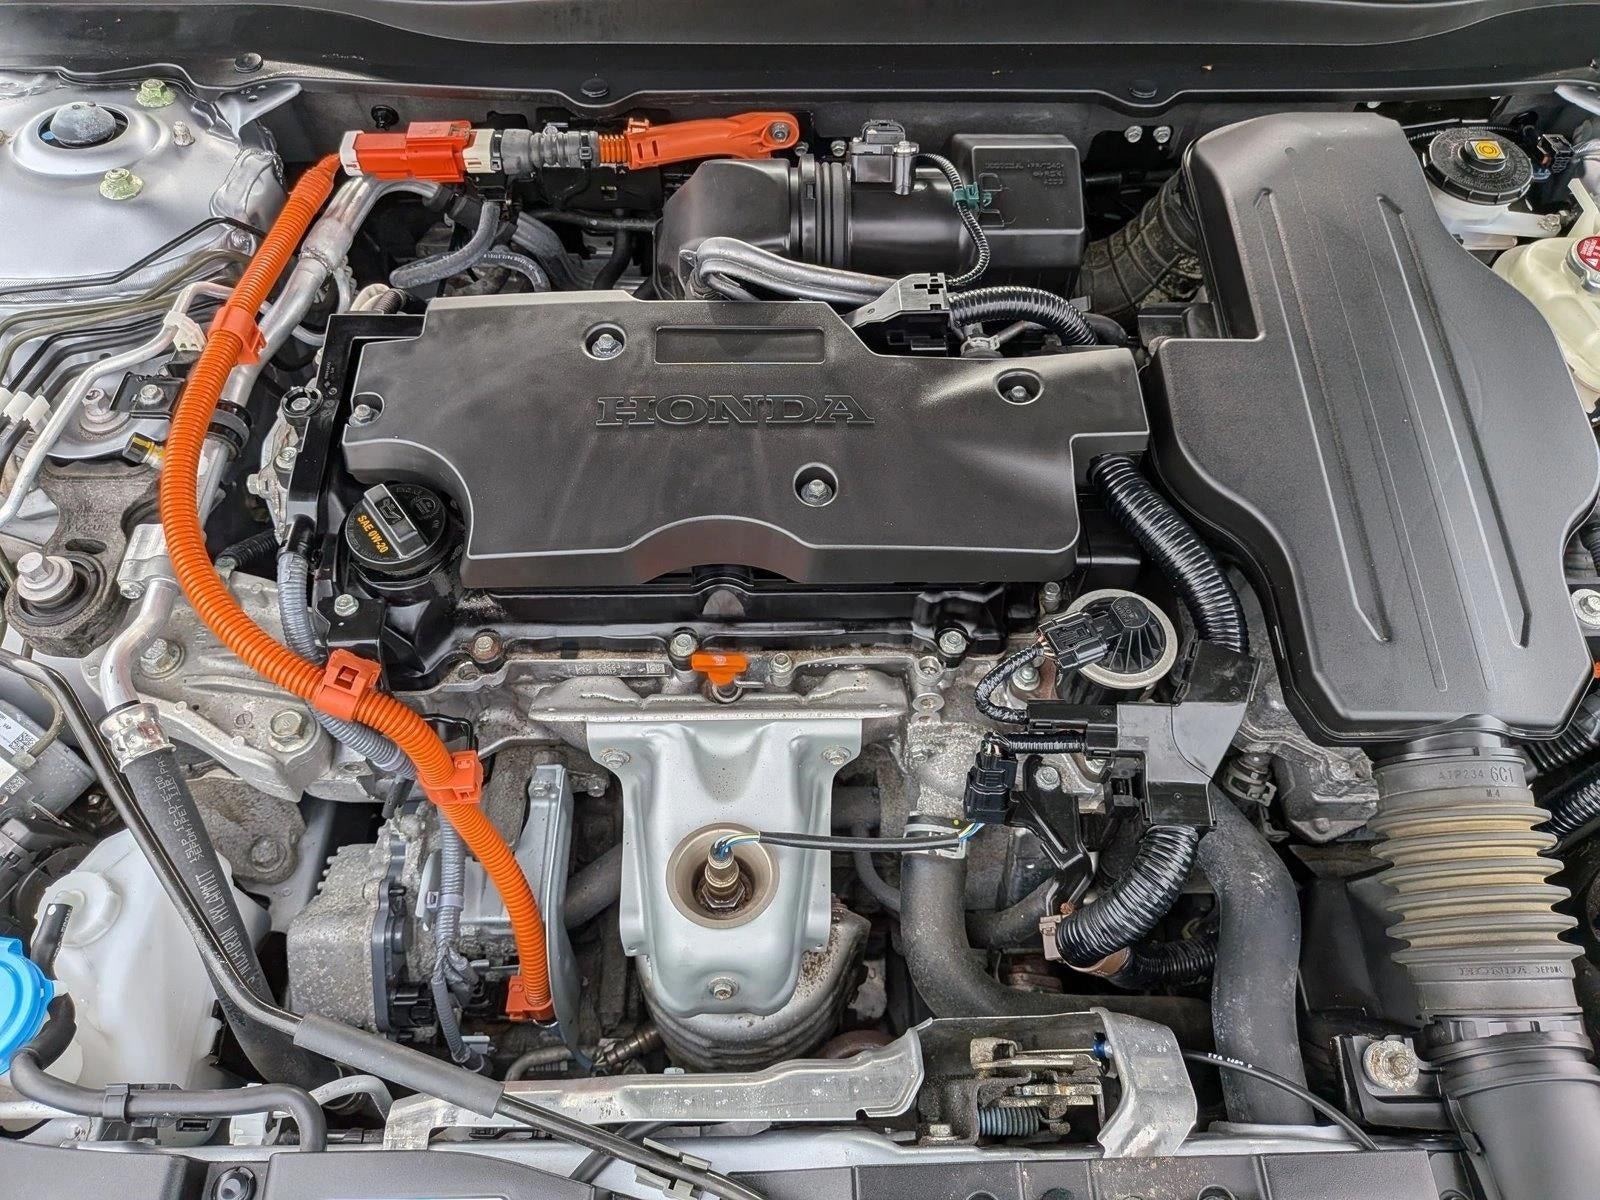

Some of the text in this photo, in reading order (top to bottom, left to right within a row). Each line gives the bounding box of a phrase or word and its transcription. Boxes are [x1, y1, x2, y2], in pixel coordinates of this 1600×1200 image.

[596, 395, 875, 425] HONDA
[358, 515, 374, 532] SAE
[368, 530, 389, 553] 0W-20
[195, 869, 231, 925] HYLAMMIT
[220, 925, 252, 978] NICHIRIN
